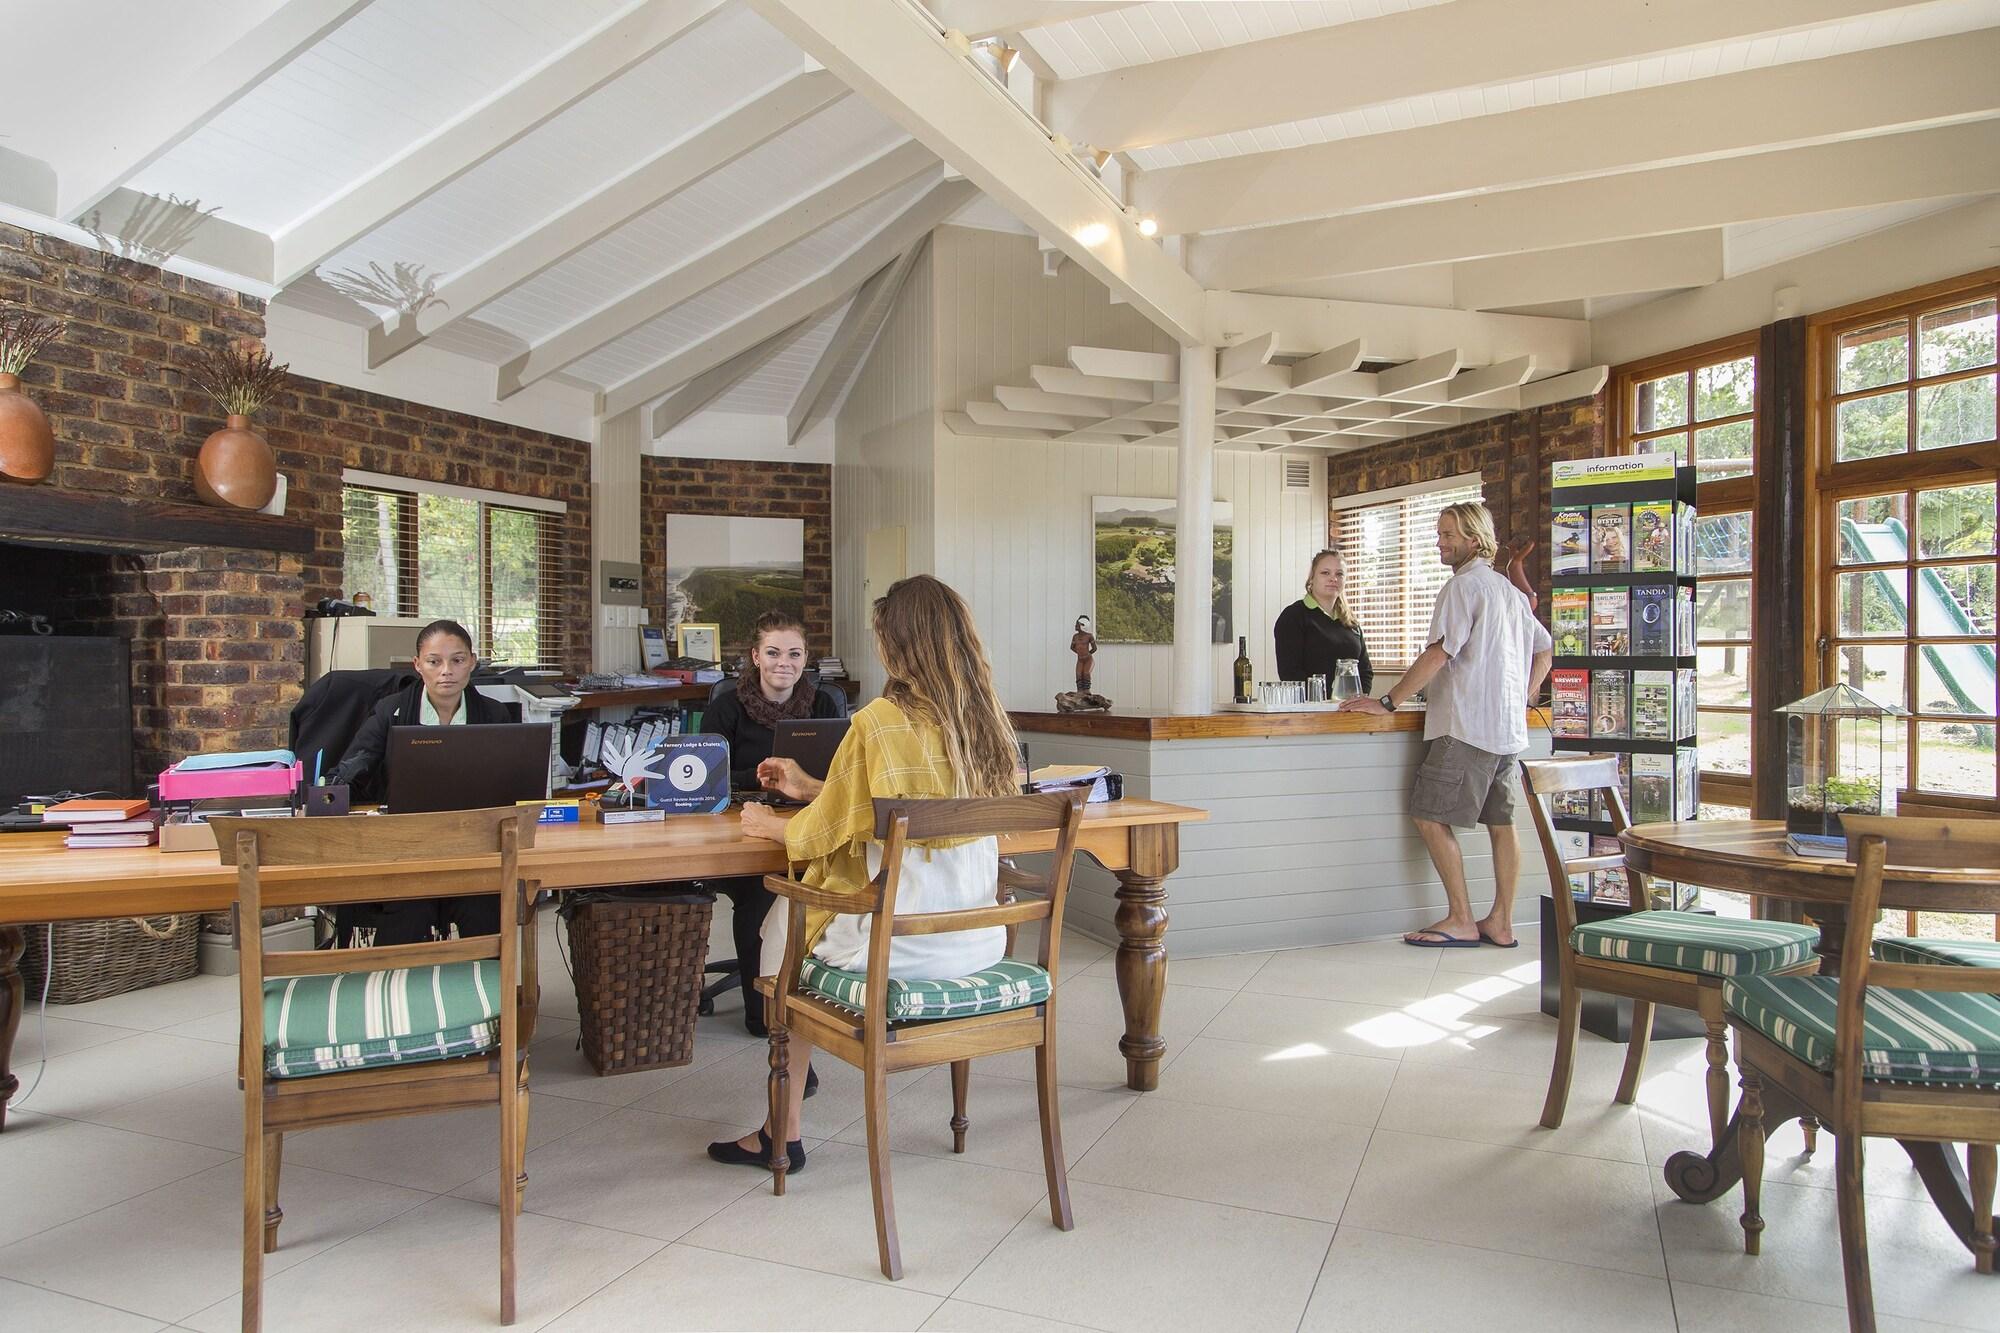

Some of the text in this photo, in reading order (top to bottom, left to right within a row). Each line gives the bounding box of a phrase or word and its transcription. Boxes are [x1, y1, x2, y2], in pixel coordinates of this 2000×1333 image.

[1587, 461, 1644, 472] information
[1636, 588, 1666, 596] TANDIA
[683, 764, 693, 779] 9
